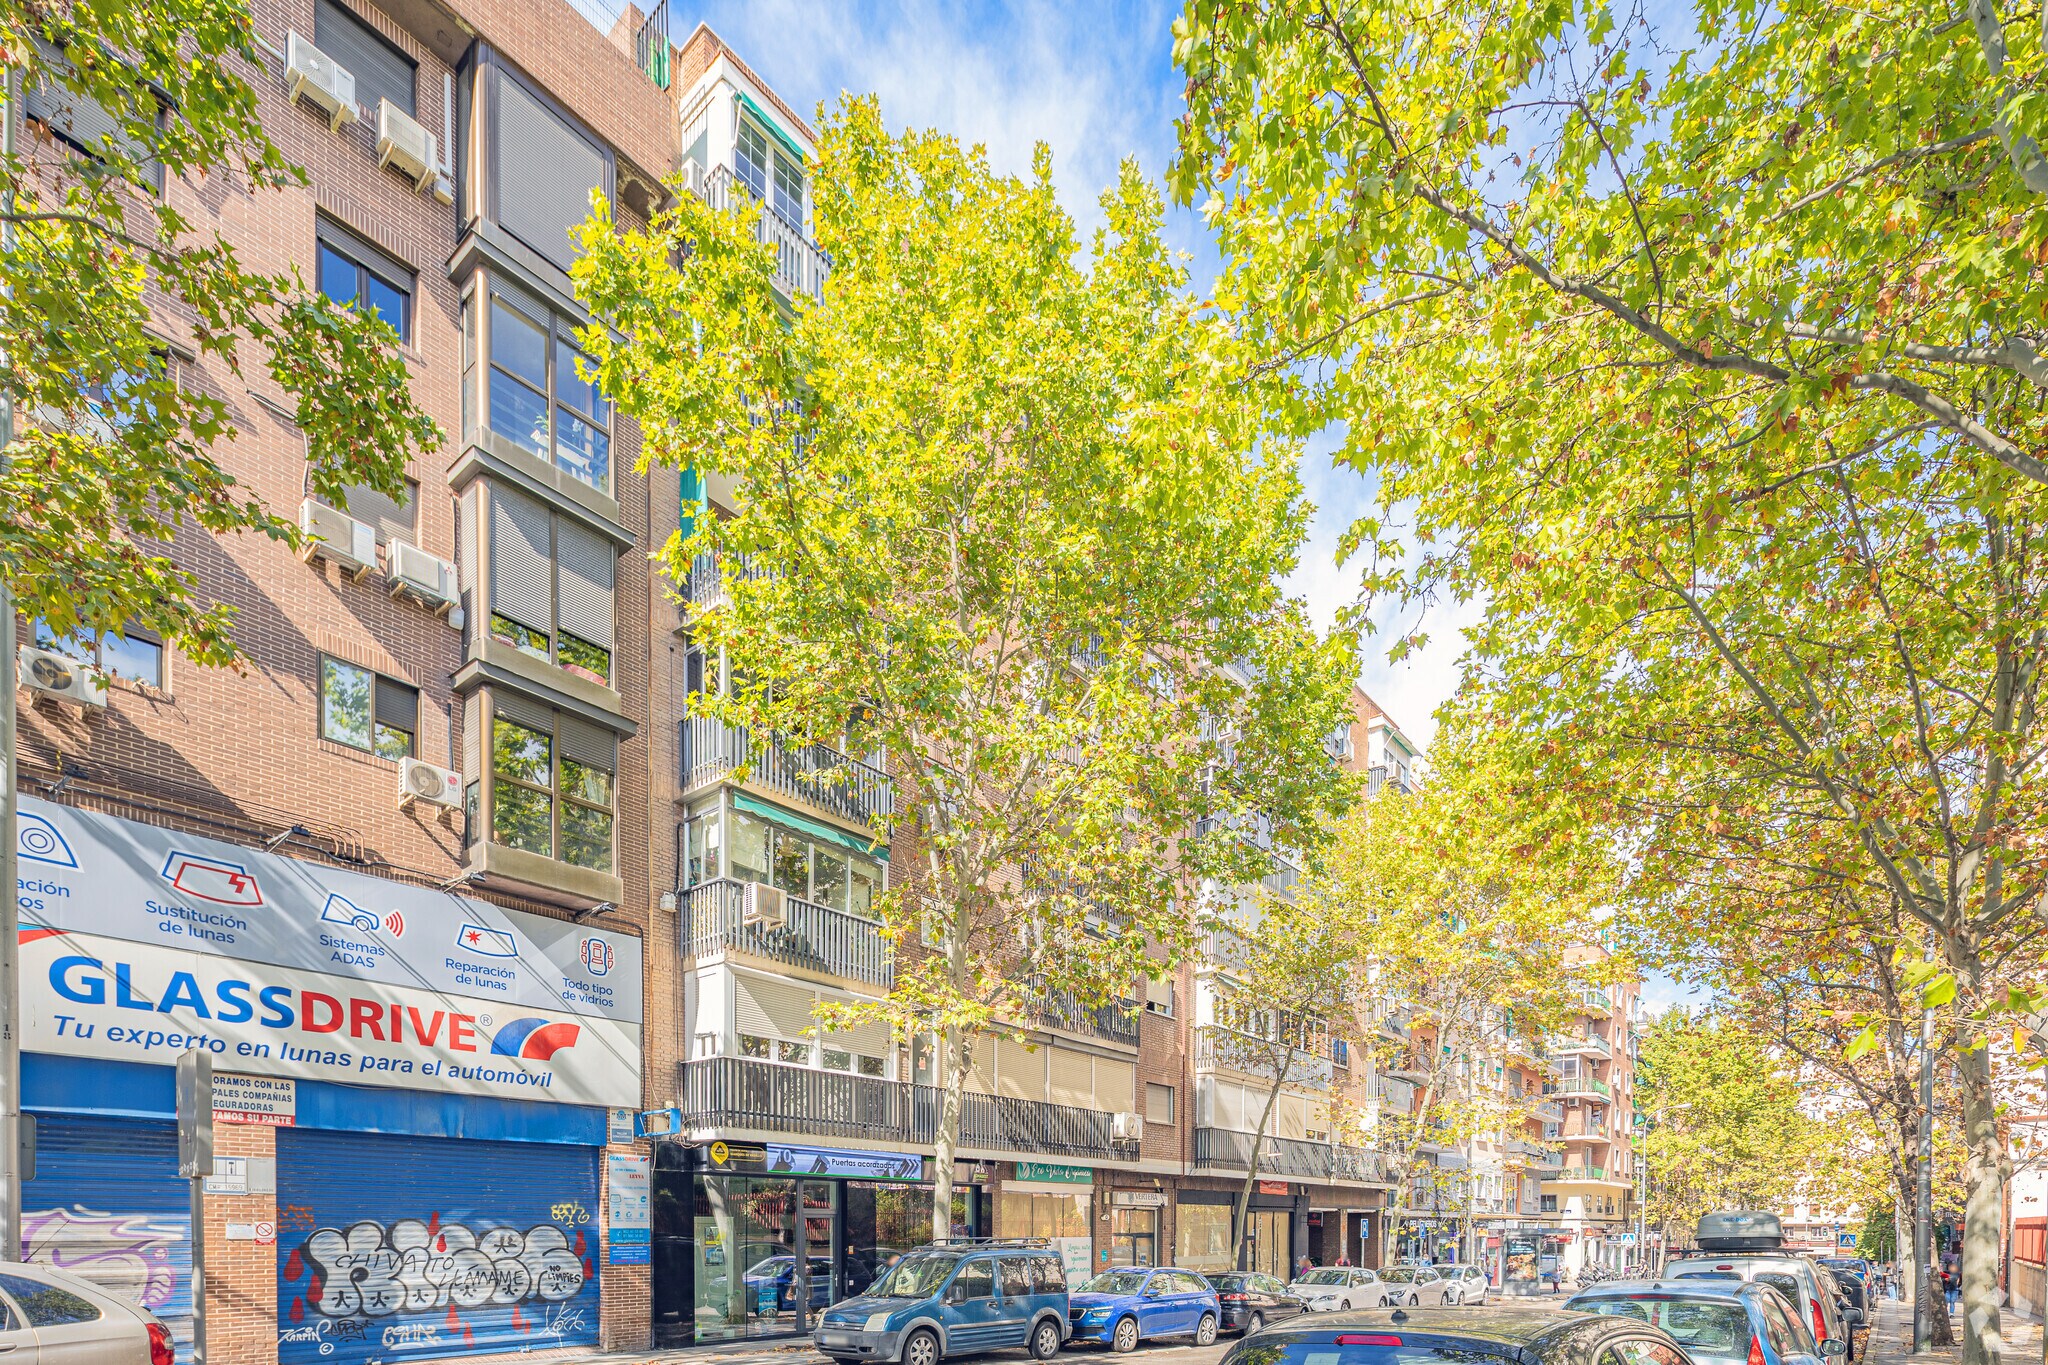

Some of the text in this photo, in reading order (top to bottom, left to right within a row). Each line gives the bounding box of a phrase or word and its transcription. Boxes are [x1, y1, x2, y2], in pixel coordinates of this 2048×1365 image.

[17, 878, 70, 898] ación
[18, 896, 44, 910] os
[145, 900, 247, 931] Sustitución
[159, 920, 235, 944] de lunas
[320, 934, 385, 956] Sistemas
[331, 951, 375, 968] ADAS
[445, 958, 516, 979] Reparación
[455, 974, 507, 991] de lunas
[562, 977, 613, 996] Todo tipo
[562, 990, 614, 1008] de vidrios
[53, 1015, 552, 1088] Tu experto en lunas para el automóvil
[213, 1076, 291, 1091] ORAMOS CON LAS
[212, 1088, 292, 1102] PALES COMPAÑIAS
[213, 1099, 274, 1112] EGURADORAS
[212, 1110, 292, 1125] TAMOS SU PARTE
[831, 1158, 896, 1169] Puertas acorazadas
